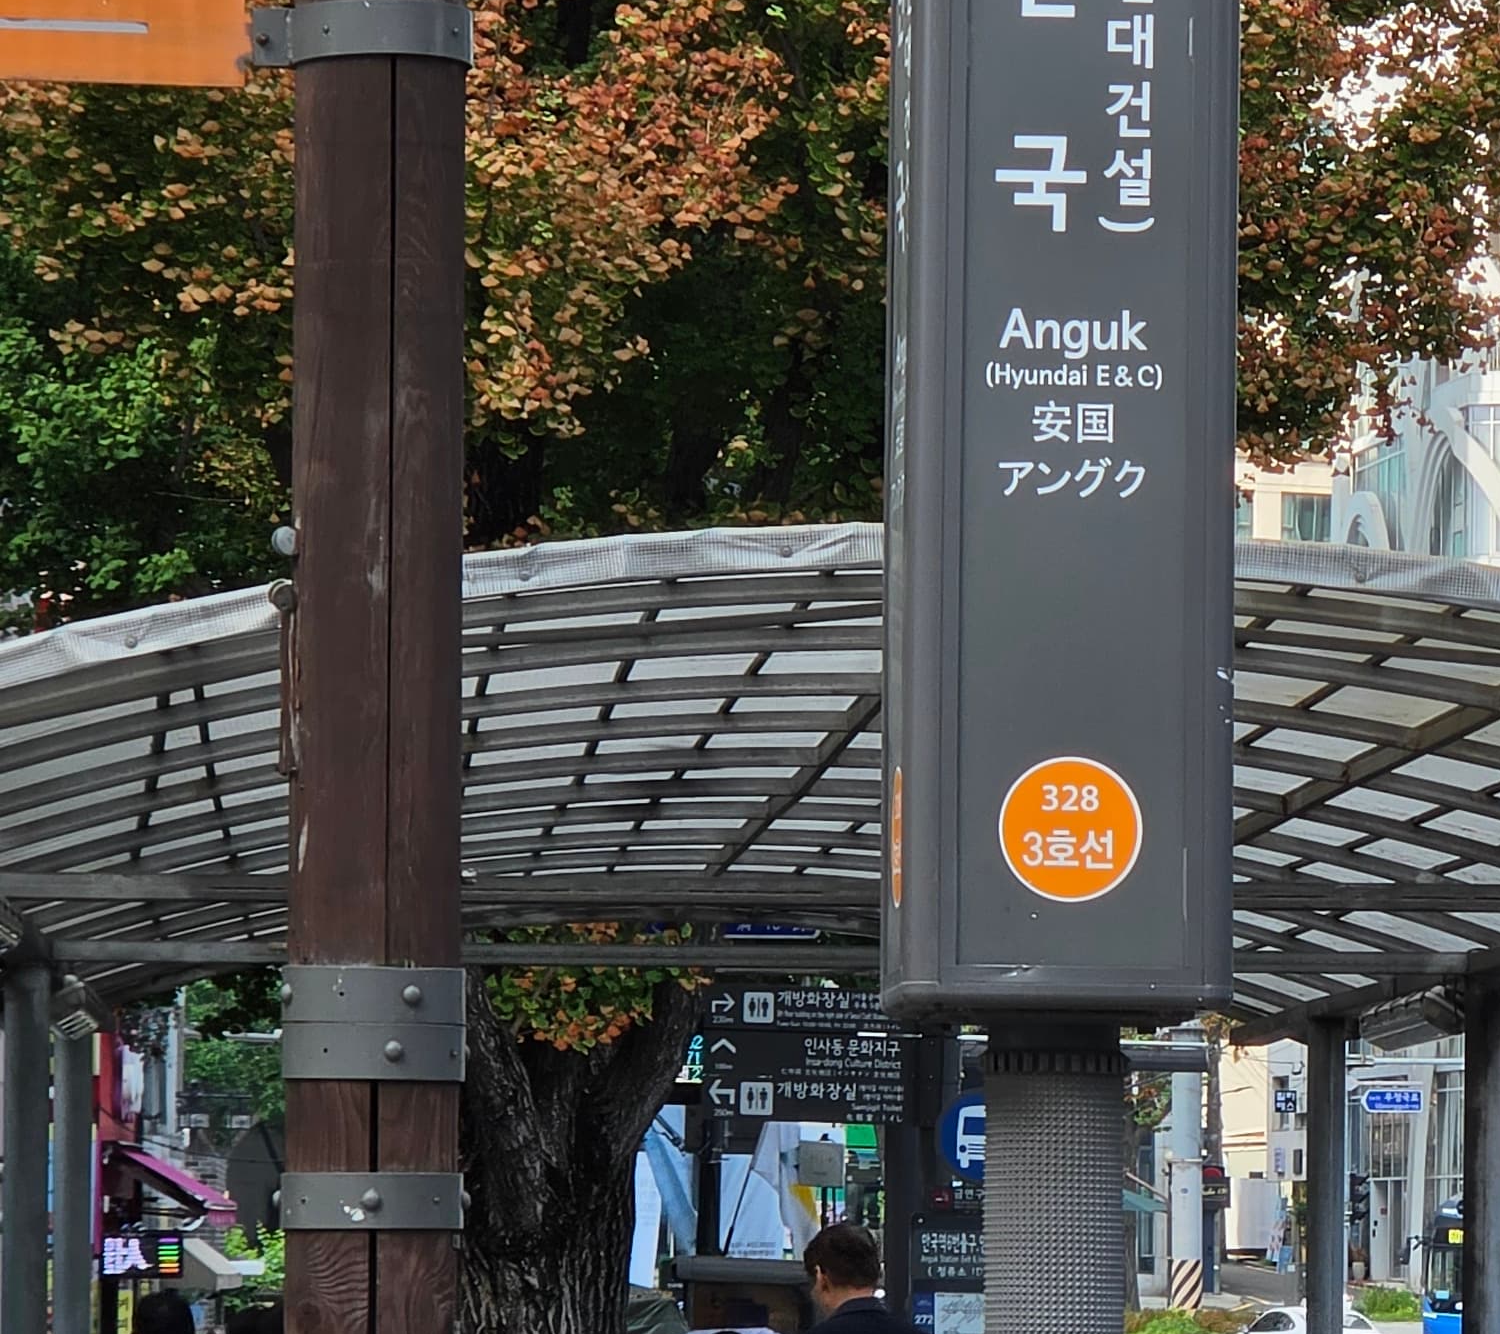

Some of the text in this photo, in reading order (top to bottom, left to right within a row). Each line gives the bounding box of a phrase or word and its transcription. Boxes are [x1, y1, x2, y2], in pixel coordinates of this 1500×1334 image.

[998, 307, 1148, 359] Anguk
[984, 361, 1089, 390] (Hyundai
[1031, 400, 1115, 444] 安国
[997, 457, 1148, 500] アングク
[1041, 784, 1100, 812] 328
[1021, 829, 1115, 870] 3호선
[776, 990, 850, 1009] 개방화장실
[804, 1037, 901, 1058] 인사동 문화지구
[777, 1081, 857, 1101] 개방화장실
